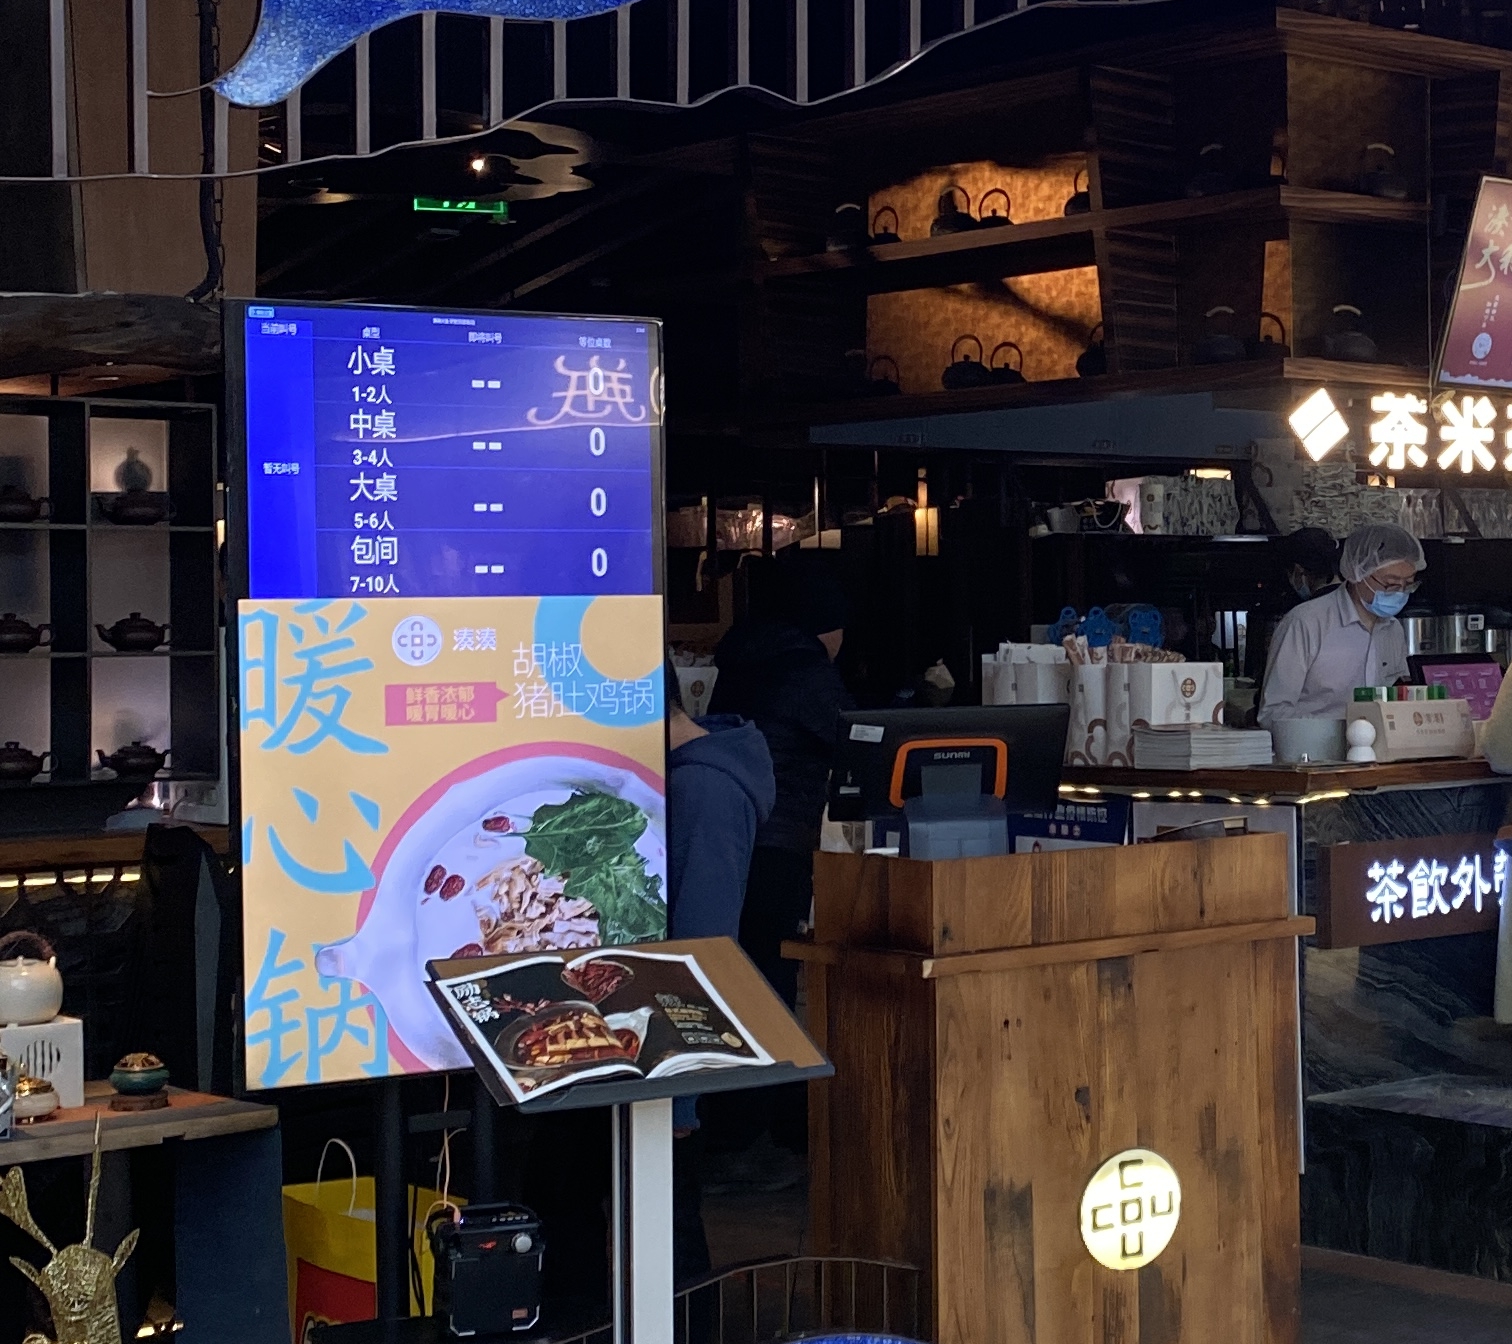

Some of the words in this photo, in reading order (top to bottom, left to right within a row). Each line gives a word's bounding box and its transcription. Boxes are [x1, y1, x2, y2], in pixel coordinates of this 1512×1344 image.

[347, 345, 395, 376] 小桌
[352, 386, 393, 405] 1-2人
[588, 367, 604, 396] 0
[350, 408, 397, 440] 中桌
[589, 427, 605, 456] 0
[352, 448, 393, 467] 3-4人
[350, 472, 398, 503] 大桌
[590, 487, 607, 517] 0
[354, 512, 395, 530] 5-6人
[350, 535, 398, 566] 包间
[591, 548, 608, 577] 0
[350, 575, 400, 594] 7-10人
[512, 641, 584, 678] 胡椒
[405, 685, 475, 705] 鲜香浓郁
[513, 678, 655, 719] 猪肚鸡锅
